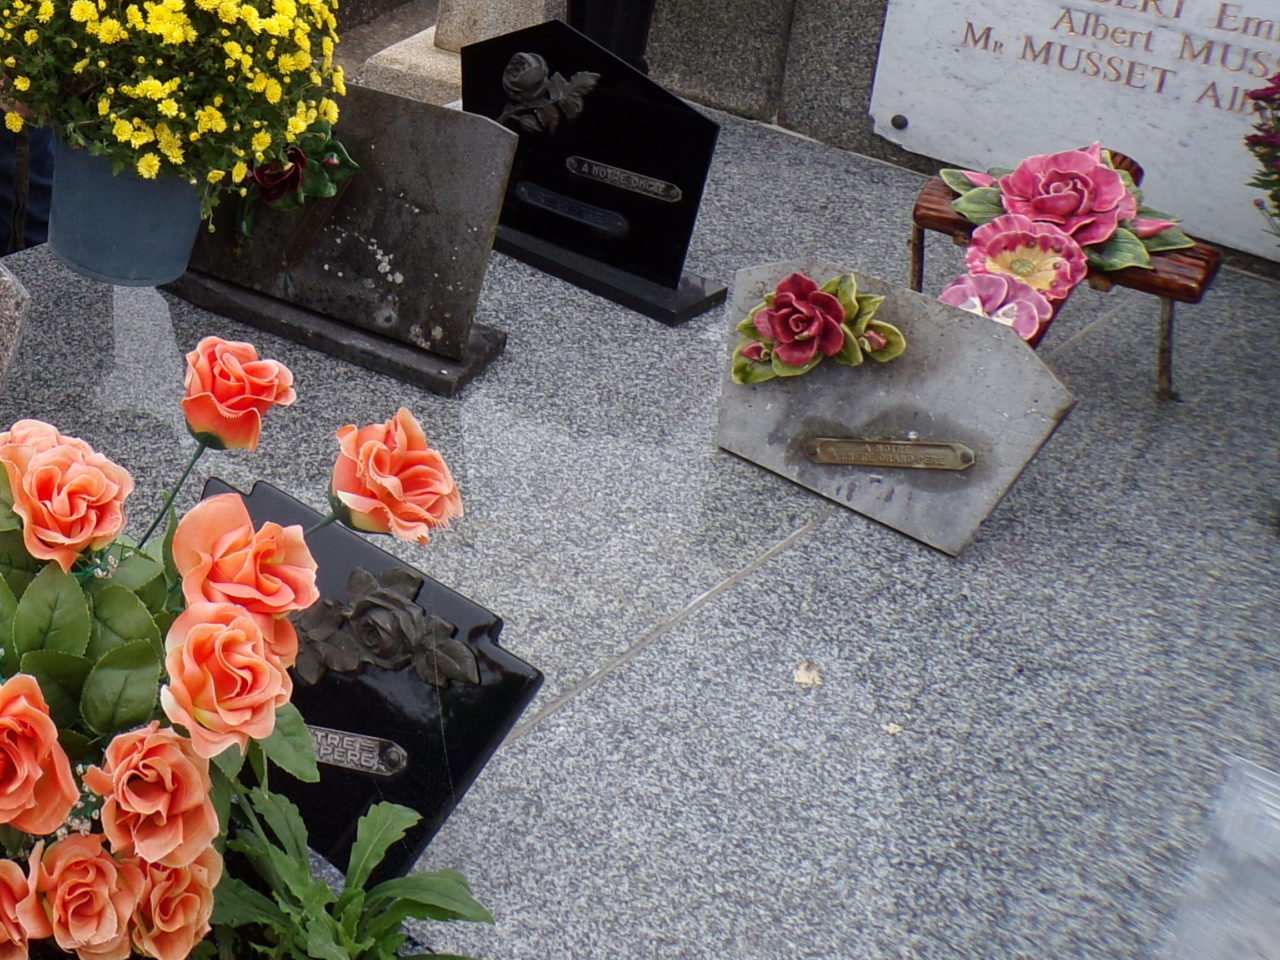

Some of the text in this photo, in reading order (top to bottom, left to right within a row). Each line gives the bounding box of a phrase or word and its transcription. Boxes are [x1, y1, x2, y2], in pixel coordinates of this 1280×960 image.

[1050, 8, 1280, 79] Albert MUS
[1215, 2, 1280, 41] Em
[1019, 34, 1177, 95] MUSSET
[592, 165, 627, 185] NOTRE
